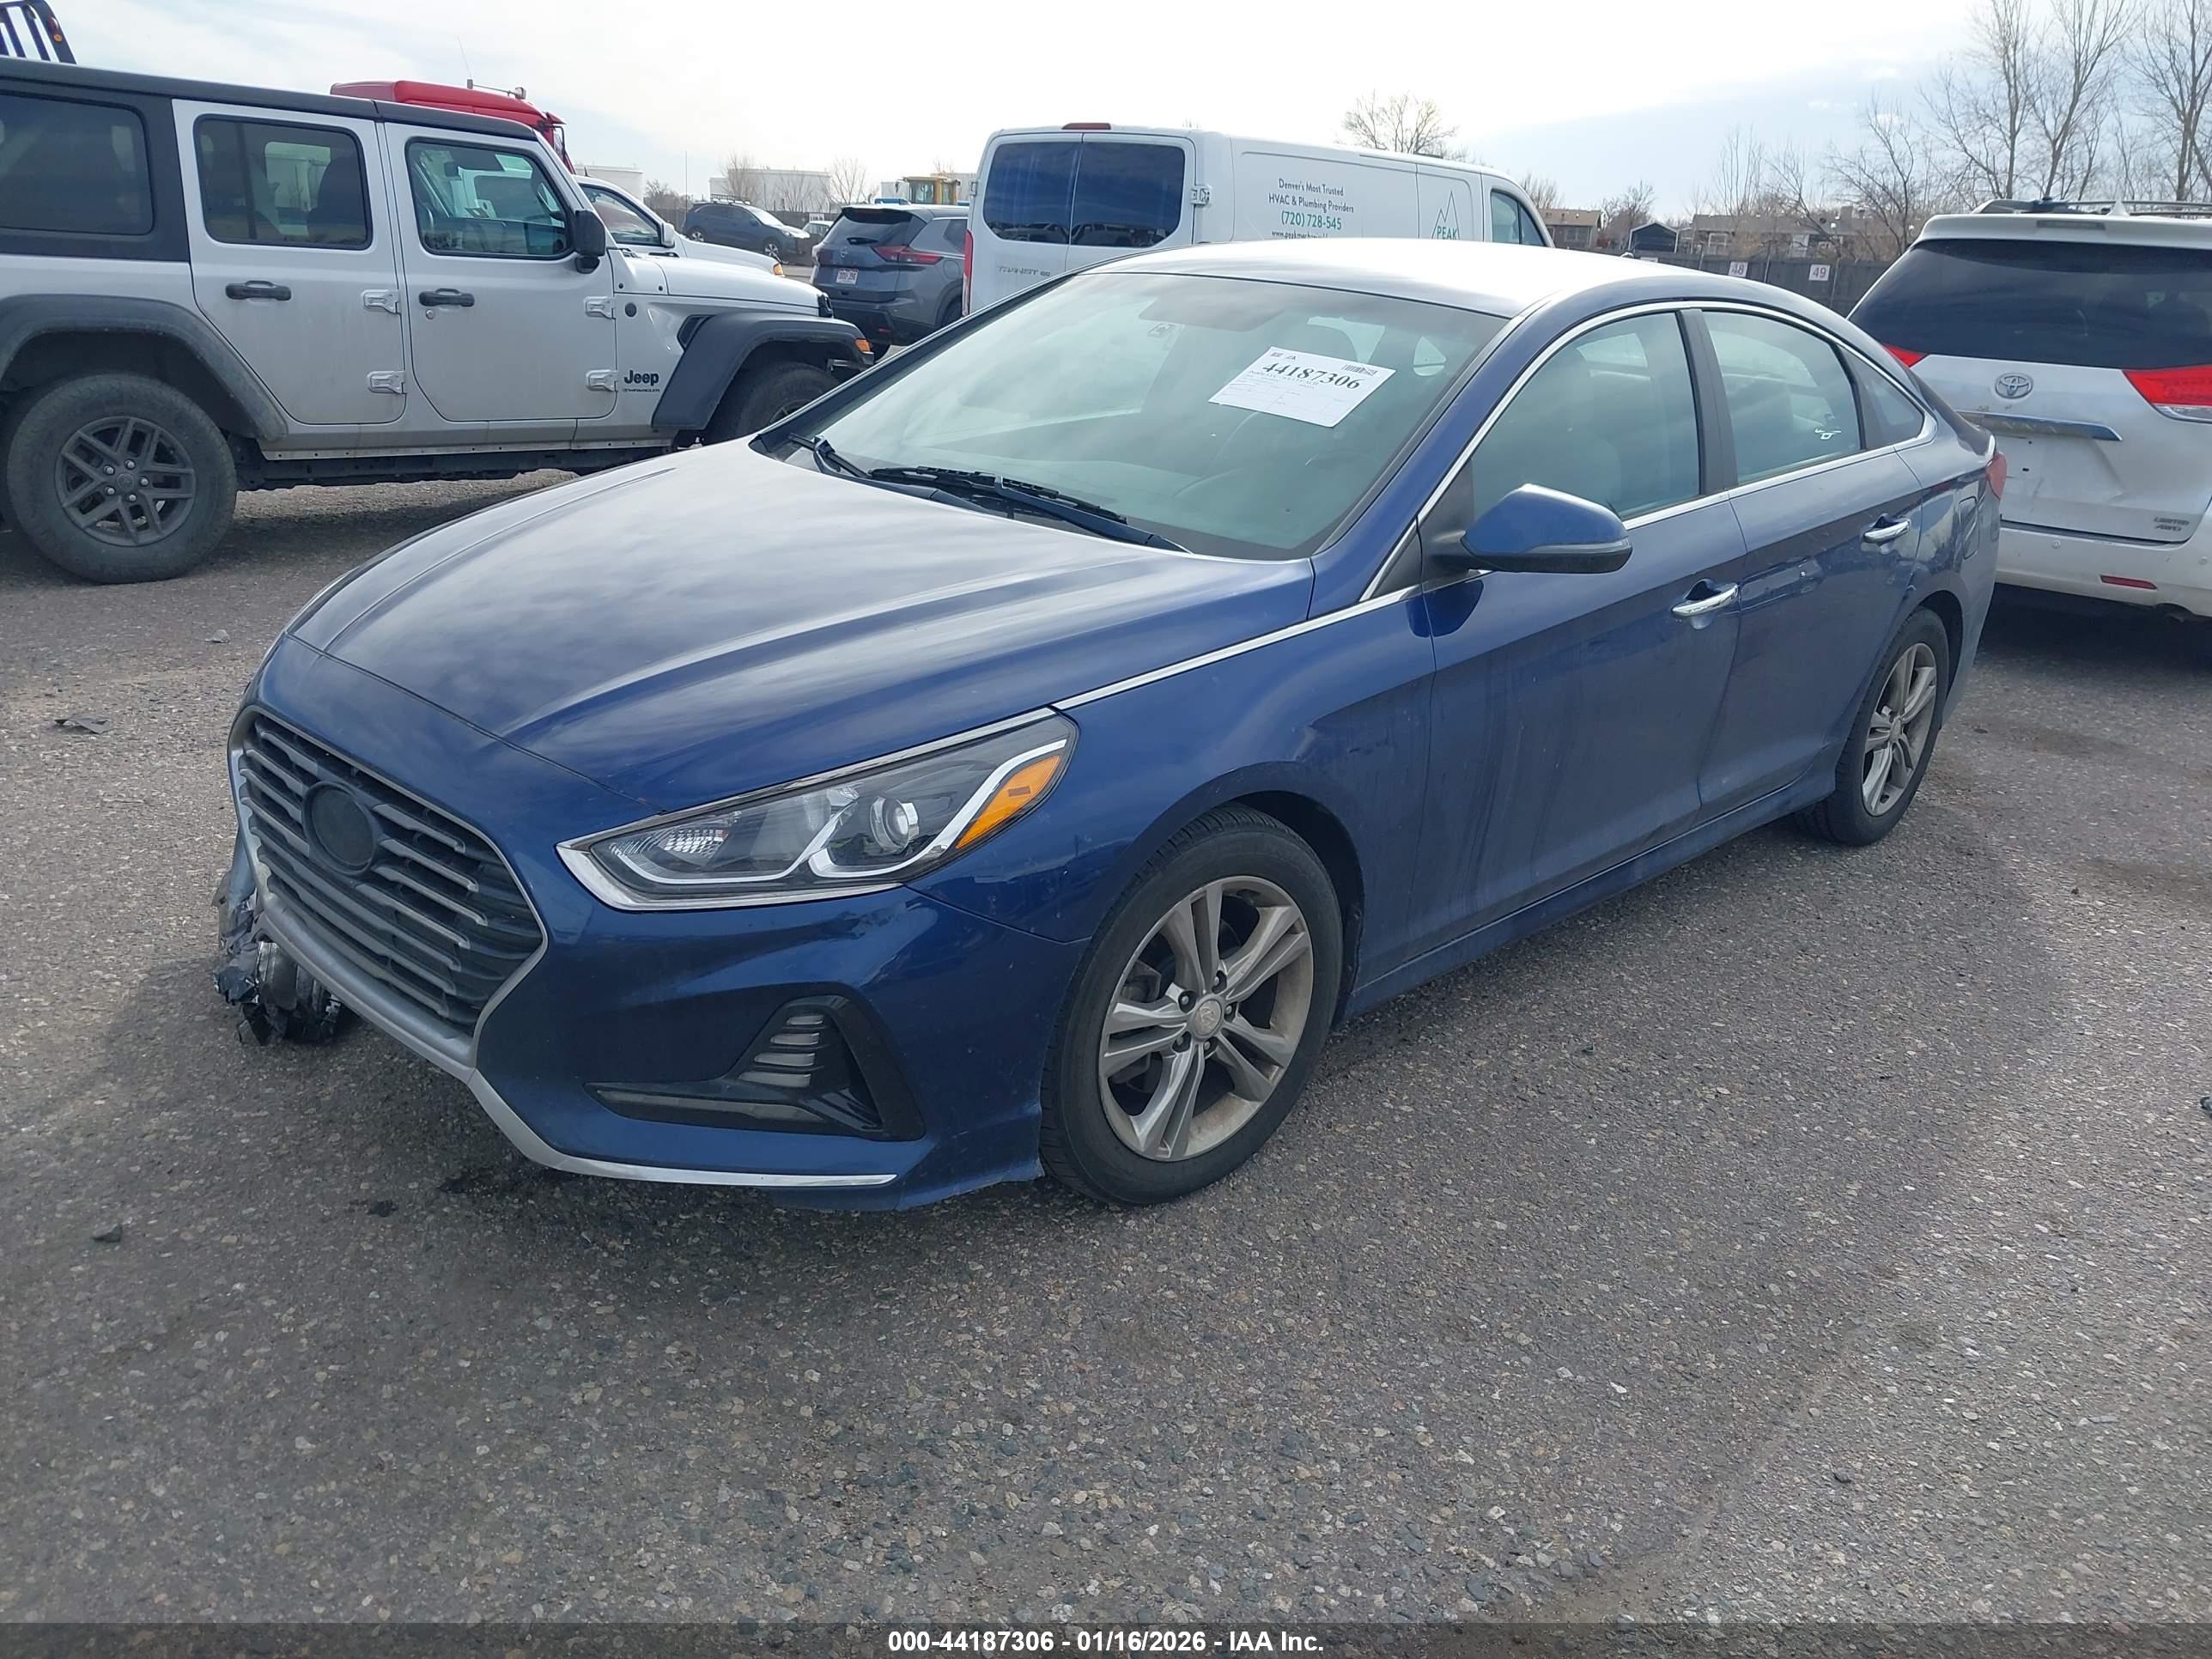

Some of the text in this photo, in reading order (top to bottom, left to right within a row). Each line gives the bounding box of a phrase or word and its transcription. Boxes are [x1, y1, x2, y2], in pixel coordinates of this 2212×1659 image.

[1279, 177, 1344, 197] Denver's Most Trusted
[1268, 192, 1354, 214] HVAC & Plumbing Providers
[1281, 210, 1342, 231] (720) 728-545
[1437, 225, 1457, 240] PEAK
[1813, 267, 1826, 278] 49
[623, 369, 659, 386] Jeep
[1262, 362, 1366, 390] 44187306
